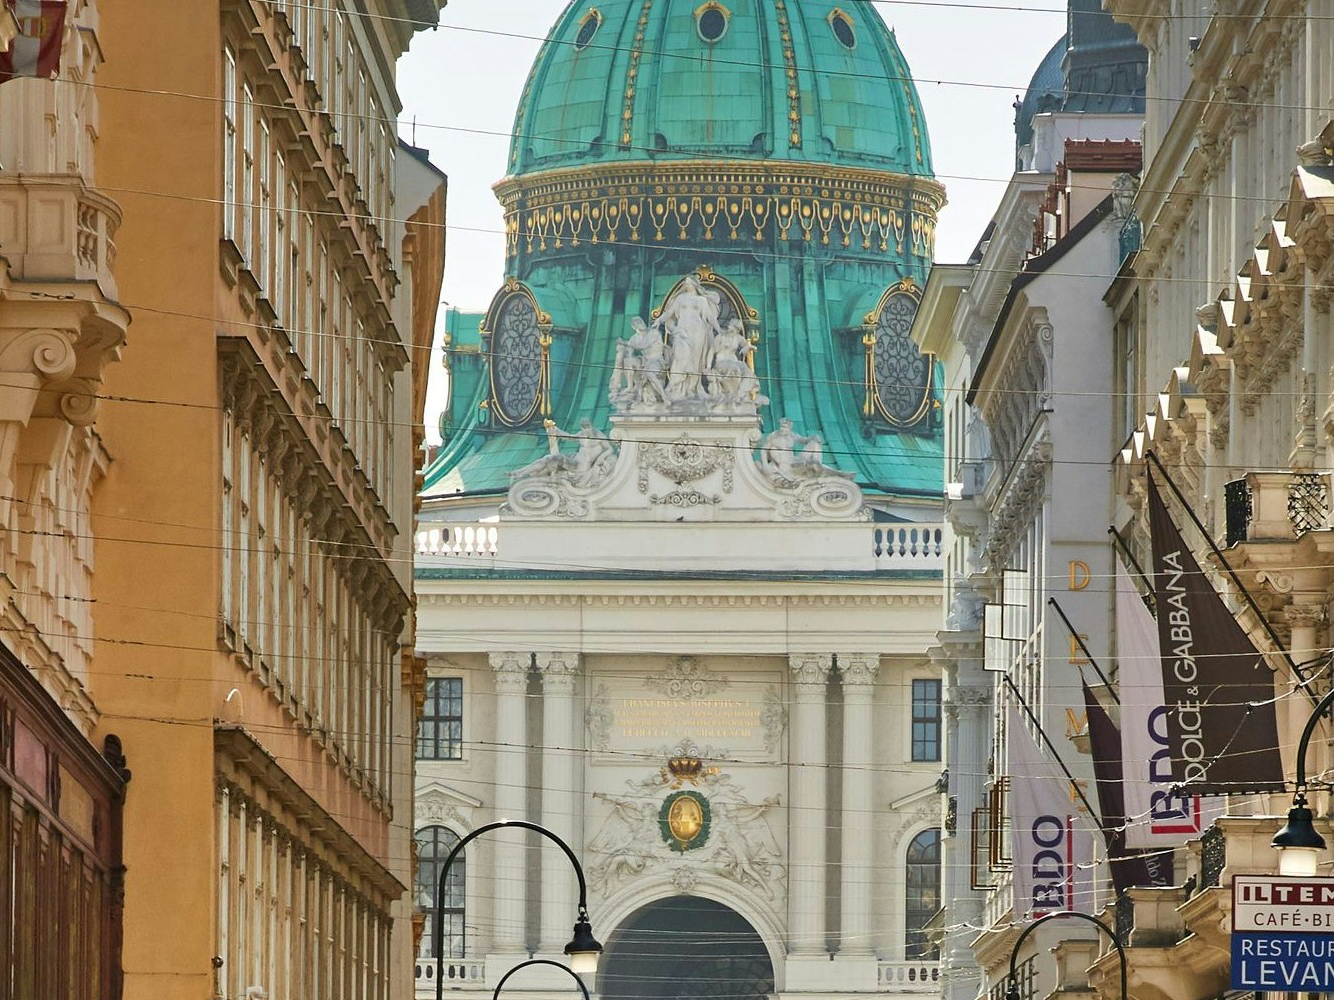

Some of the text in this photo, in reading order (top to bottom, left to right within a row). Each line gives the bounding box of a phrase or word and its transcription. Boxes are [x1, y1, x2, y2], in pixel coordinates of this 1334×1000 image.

[1162, 551, 1206, 784] DOLCE & GABBANA
[1033, 814, 1064, 908] BDO
